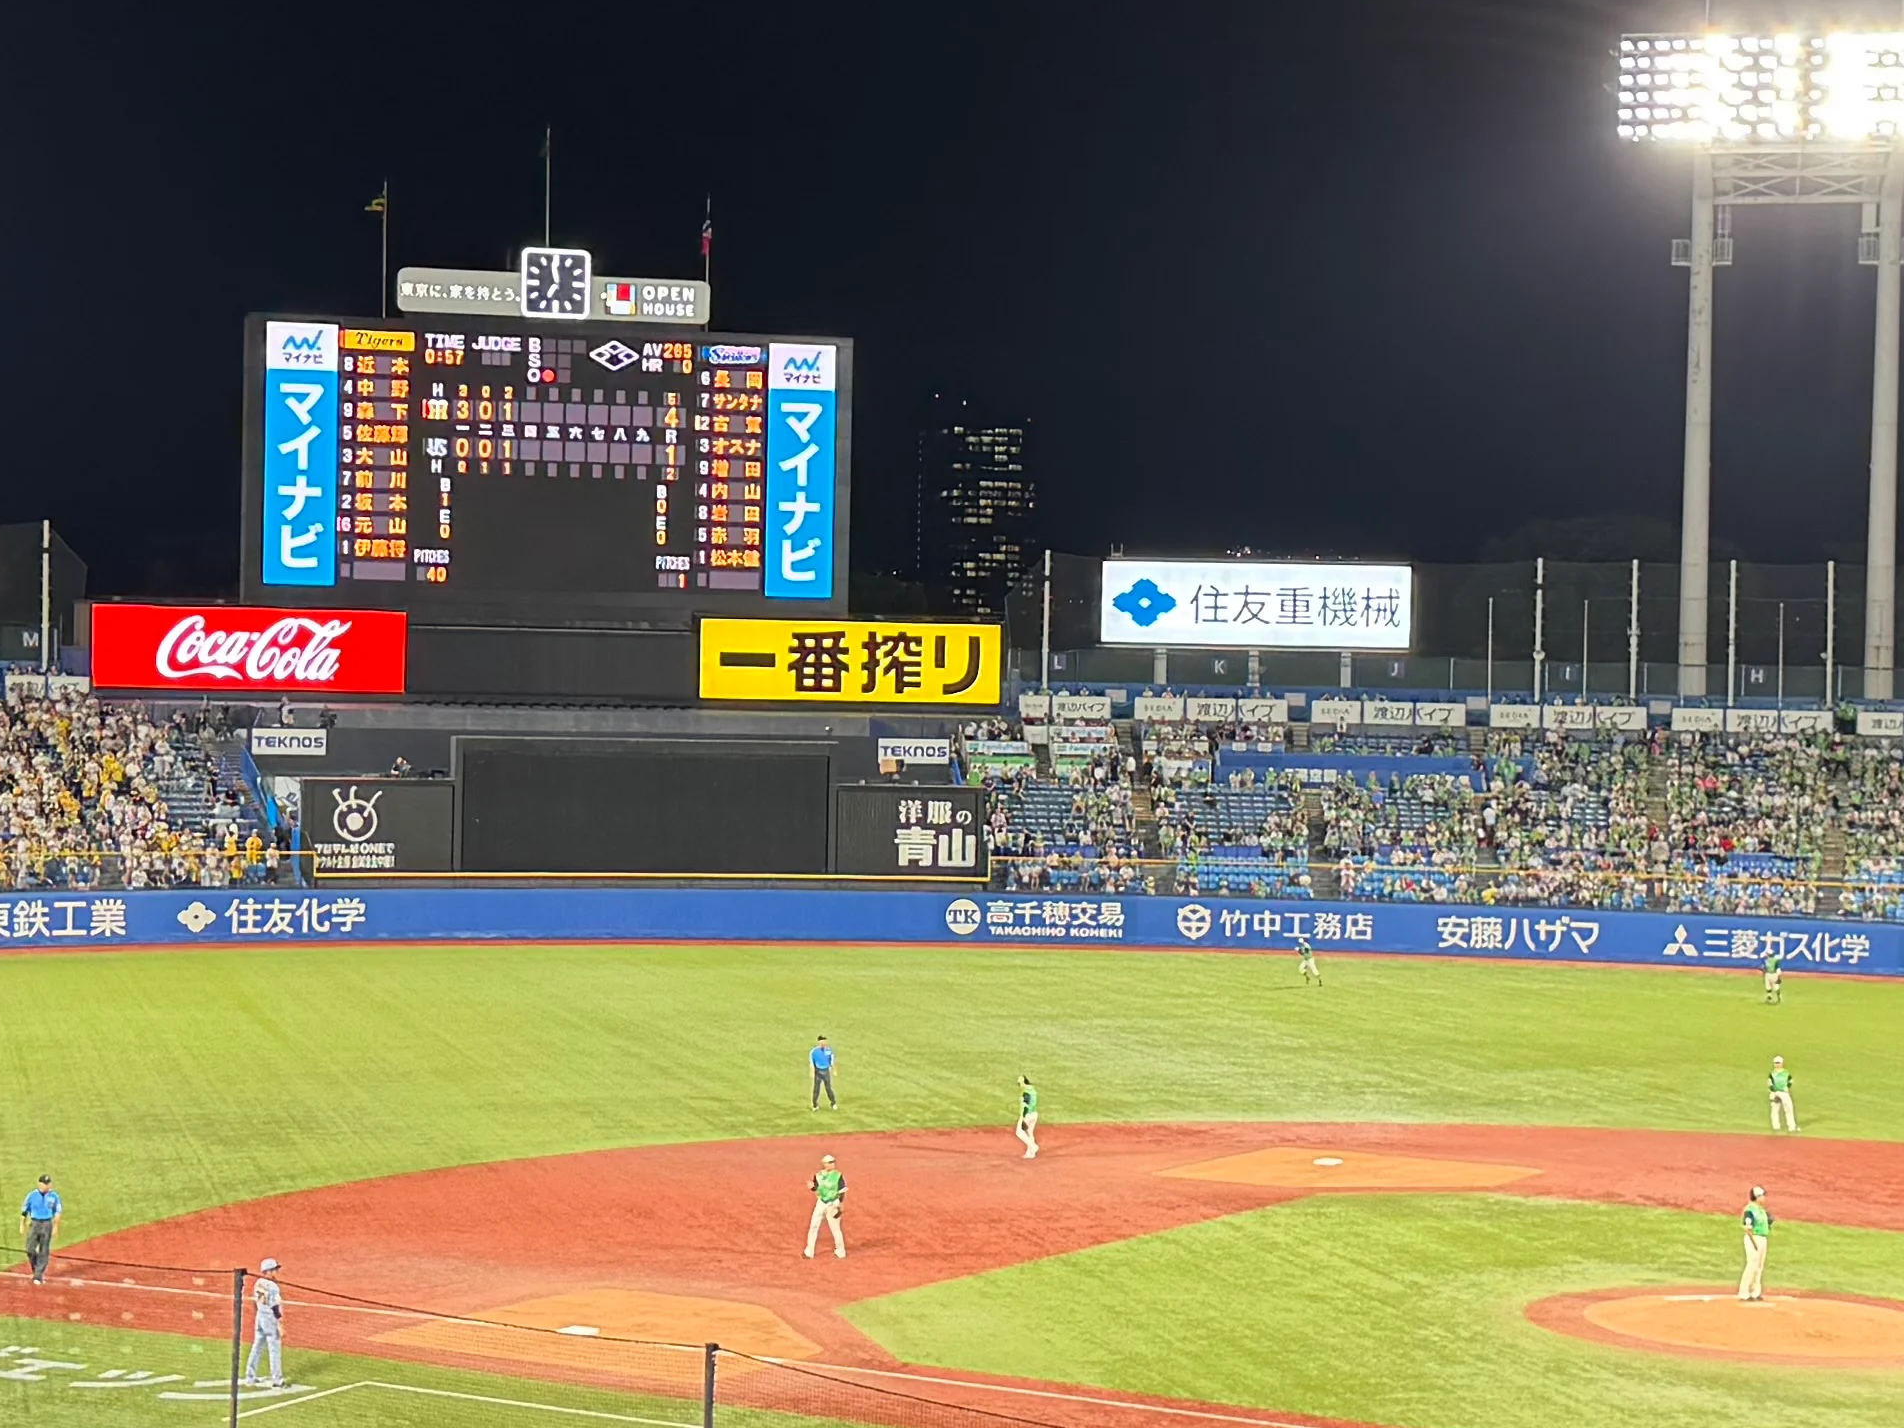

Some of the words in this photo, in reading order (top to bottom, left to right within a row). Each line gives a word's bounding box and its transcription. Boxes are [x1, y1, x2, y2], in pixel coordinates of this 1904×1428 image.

[400, 282, 521, 302] 東京に、家を持とう。
[642, 285, 695, 301] OPEN
[642, 302, 694, 317] HOUSE
[355, 331, 404, 350] Tigers
[424, 333, 465, 349] TIME
[472, 335, 522, 352] JUDGE
[528, 337, 541, 353] B
[281, 350, 324, 365] マイナビ
[424, 349, 465, 366] 0:57
[642, 343, 663, 358] AV
[343, 357, 354, 372] 8
[356, 356, 410, 375] 近本
[528, 353, 541, 368] S
[642, 358, 663, 373] HR
[782, 370, 822, 386] マイナビ
[343, 380, 353, 395] 4
[356, 379, 410, 398] 中野
[343, 402, 353, 417] 9
[356, 401, 409, 421] 森下
[713, 392, 763, 411] サンタナ
[456, 401, 470, 420] 3
[478, 401, 493, 420] 0
[503, 402, 512, 420] 1
[663, 407, 679, 427] 4
[343, 425, 353, 441] 5
[355, 424, 409, 444] 佐藤輝
[591, 426, 606, 440] 七
[613, 427, 628, 441] 八
[635, 427, 651, 442] 九
[665, 429, 678, 444] R
[455, 438, 469, 457] 0
[478, 438, 493, 457] 0
[503, 439, 512, 458] 1
[665, 444, 676, 463] 1
[712, 437, 762, 456] オスナ
[342, 448, 353, 463] 3
[355, 447, 408, 467] 大山
[276, 383, 327, 569] マイナビ
[342, 470, 352, 485] 7
[355, 470, 408, 490] 前川
[711, 483, 761, 500] 内山
[775, 400, 825, 582] マイナビ
[341, 494, 352, 509] 2
[354, 516, 408, 535] 元山
[342, 540, 349, 555] 1
[426, 566, 447, 582] 40
[1189, 583, 1402, 629] 住友重機械
[23, 632, 39, 647] M
[154, 614, 353, 682] Coca-Cola
[718, 629, 985, 696] 一番搾り
[253, 735, 325, 749] TEKNOS
[880, 744, 947, 758] TEKNOS
[898, 799, 973, 825] 洋服の
[894, 824, 977, 868] 青山
[224, 896, 367, 935] 住友化学
[948, 909, 979, 924] TK
[986, 900, 1126, 926] 高千穂交易
[1220, 907, 1374, 942] 竹中工務店
[1435, 916, 1602, 955] 安藤ハザマ
[1702, 927, 1872, 965] 三菱ガス化学
